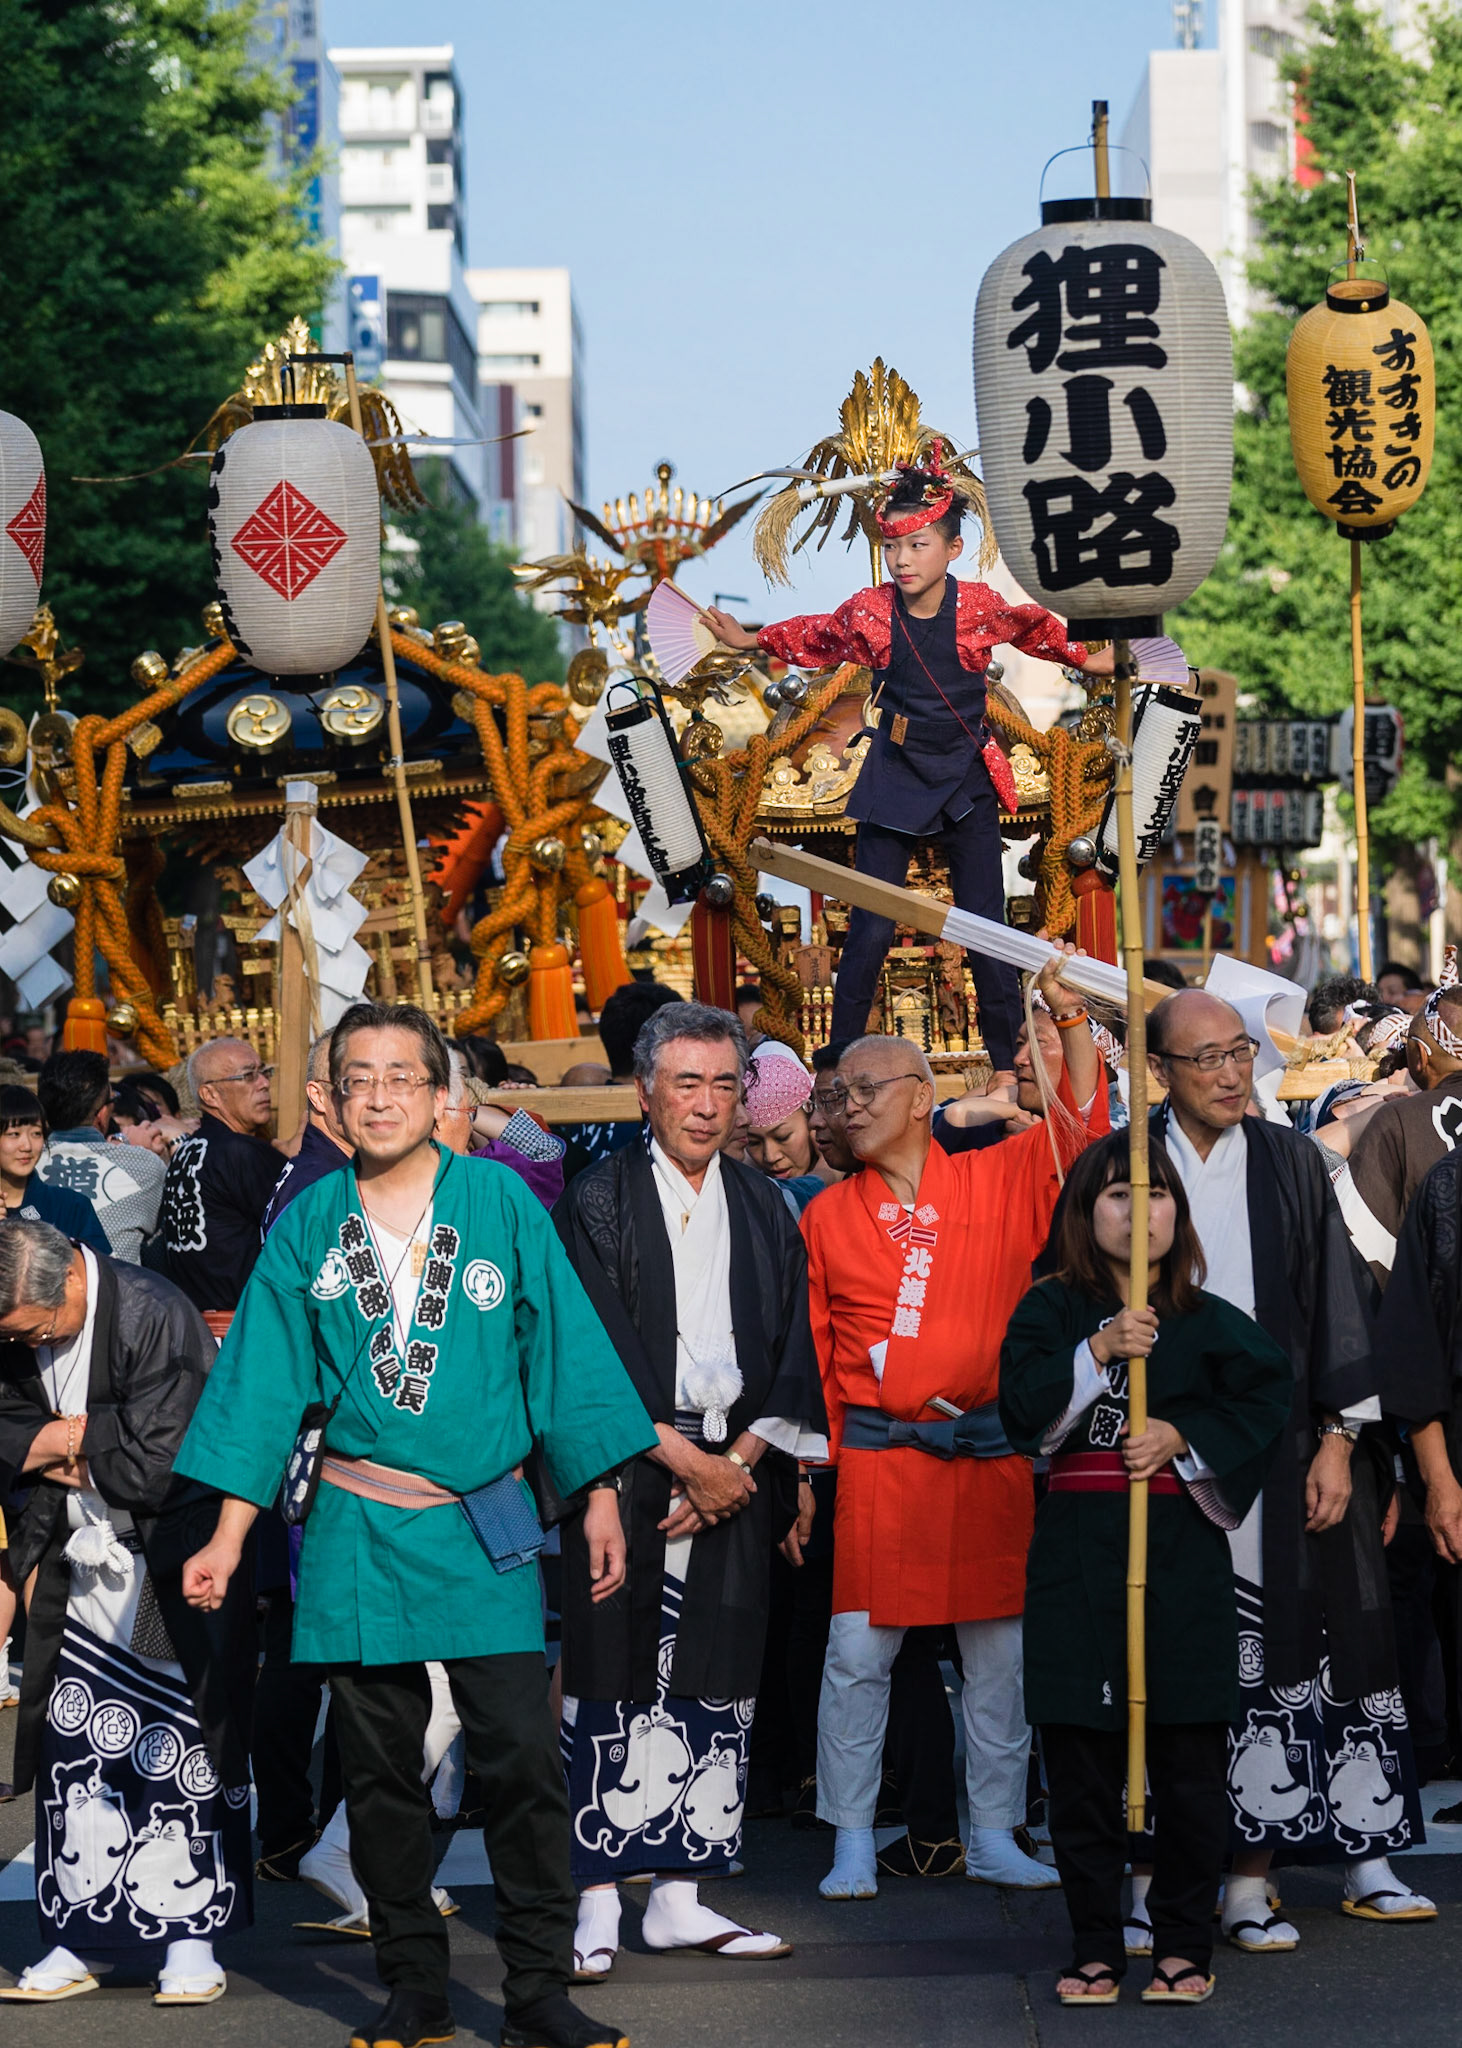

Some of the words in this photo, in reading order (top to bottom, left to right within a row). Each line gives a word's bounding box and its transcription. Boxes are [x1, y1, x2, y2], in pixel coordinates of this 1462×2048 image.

[1006, 243, 1181, 592] 狸小路
[1321, 364, 1384, 515] 観光協会
[1372, 328, 1422, 491] すすきの
[416, 1225, 459, 1328] 神輿部
[395, 1340, 438, 1414] 部長
